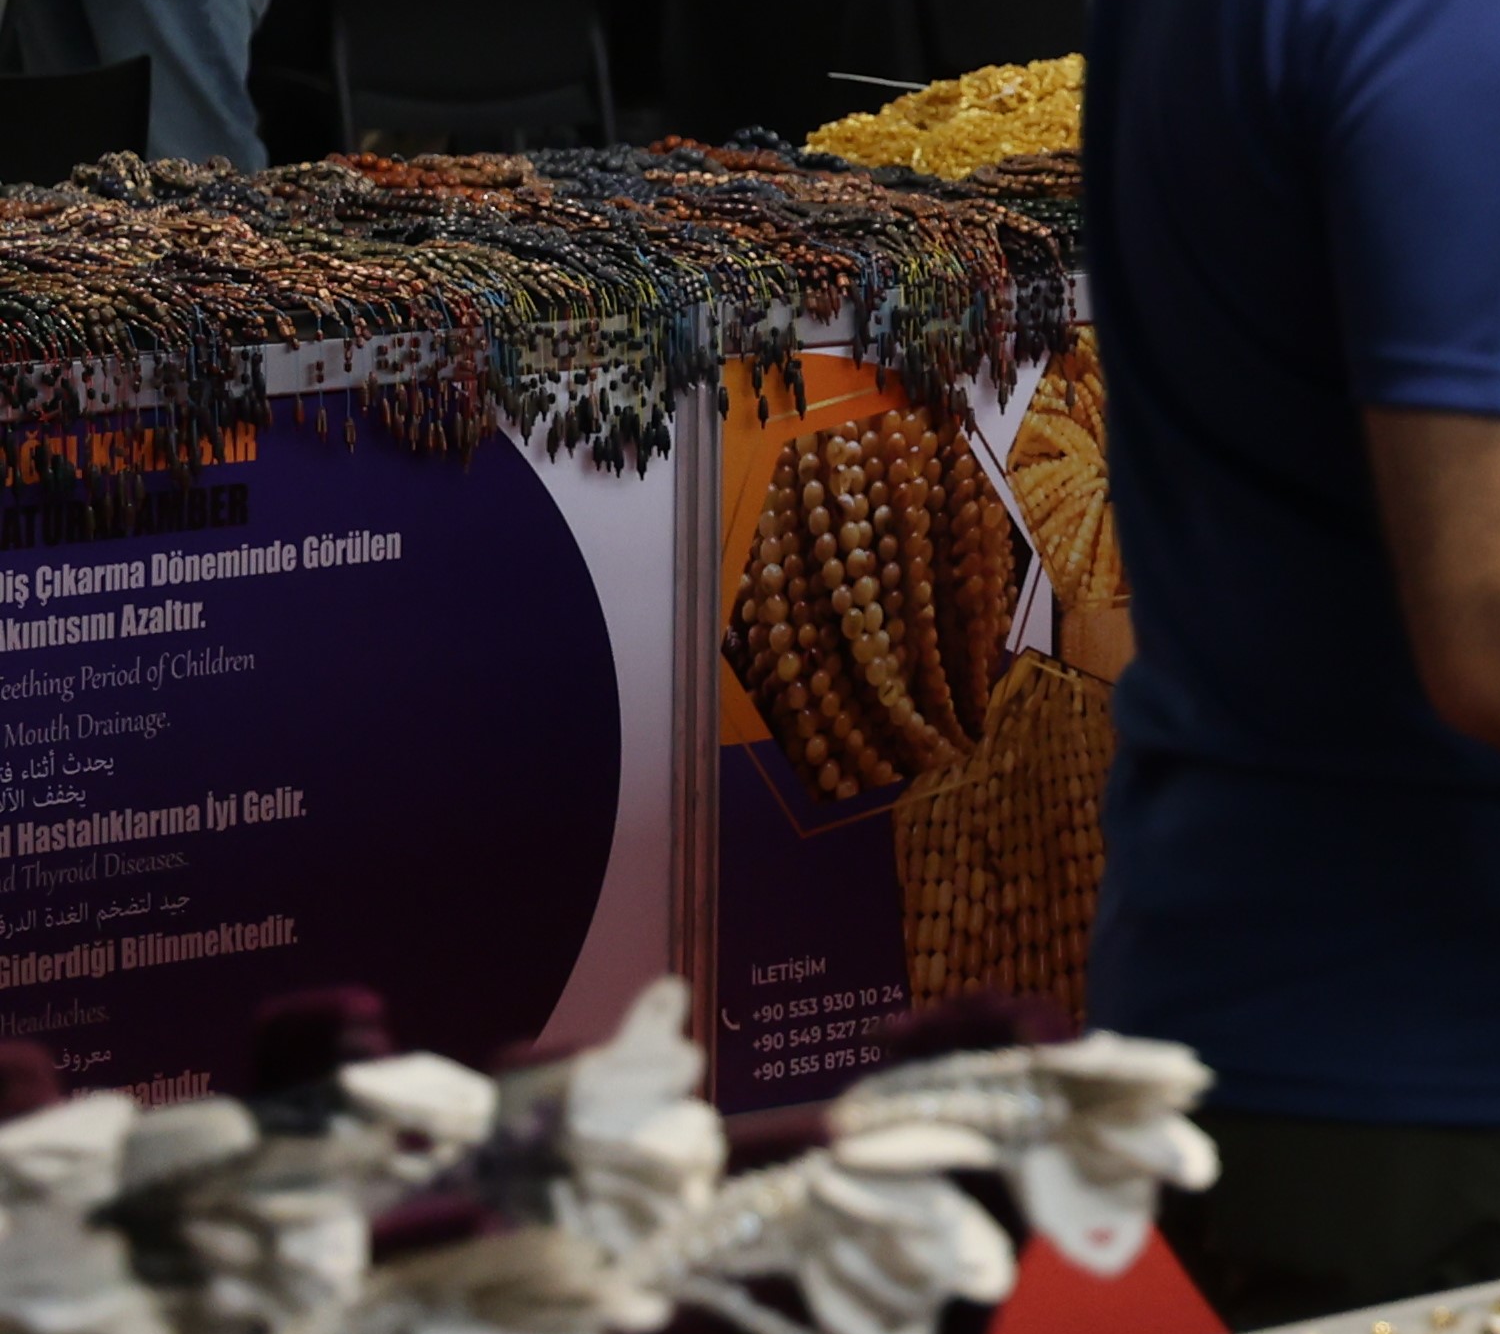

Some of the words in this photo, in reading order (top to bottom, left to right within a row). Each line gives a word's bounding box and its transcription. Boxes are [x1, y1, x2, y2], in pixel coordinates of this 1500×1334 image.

[35, 559, 146, 607] Çıkarma
[151, 540, 297, 588] Döneminde
[302, 530, 402, 567] Görülen
[120, 599, 207, 638] Azaltır.
[0, 668, 75, 702] eething
[81, 656, 142, 691] Period
[146, 652, 170, 691] of
[171, 646, 255, 680] Children
[4, 713, 70, 749] Mouth
[77, 711, 171, 739] Drainage.
[17, 804, 201, 856] Hastalıklarına
[206, 790, 237, 832] İyi
[243, 786, 307, 824] Gelir.
[20, 852, 97, 897] Thyroid
[0, 938, 115, 990] Giderdiği
[121, 914, 298, 970] Bilinmektedir.
[752, 954, 827, 986] İLETİŞİM
[752, 1003, 784, 1024] +90
[788, 997, 818, 1018] 553
[823, 991, 855, 1014] 930
[859, 988, 878, 1008] 10
[881, 984, 903, 1003] 24
[752, 1033, 785, 1054] +90
[789, 1026, 822, 1049] 549
[826, 1020, 856, 1043] 527
[752, 1061, 785, 1082] +90
[789, 1055, 820, 1078] 555
[824, 1049, 856, 1071] 875
[860, 1045, 881, 1065] 50
